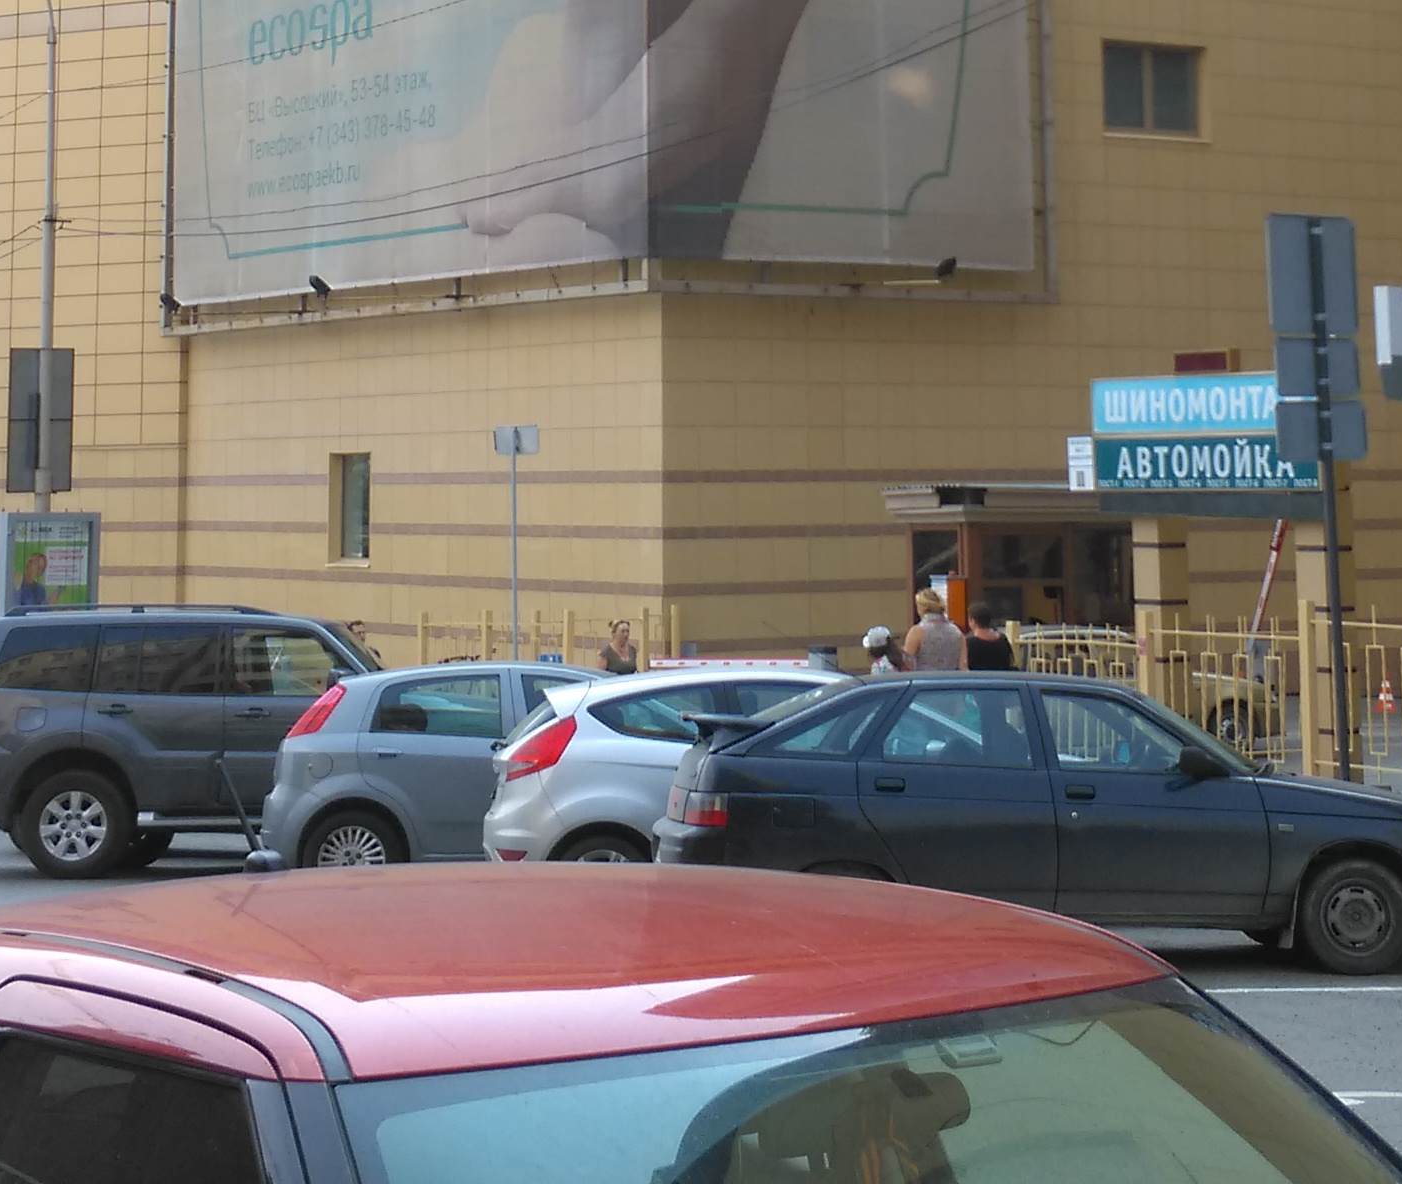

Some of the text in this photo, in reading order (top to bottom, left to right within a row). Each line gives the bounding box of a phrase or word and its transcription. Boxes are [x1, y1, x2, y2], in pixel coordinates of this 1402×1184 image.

[350, 73, 390, 103] 53-54
[326, 118, 360, 152] (343)
[1104, 385, 1278, 424] ШИНОМОНТА
[1117, 438, 1295, 480] АВТОМОЙКА
